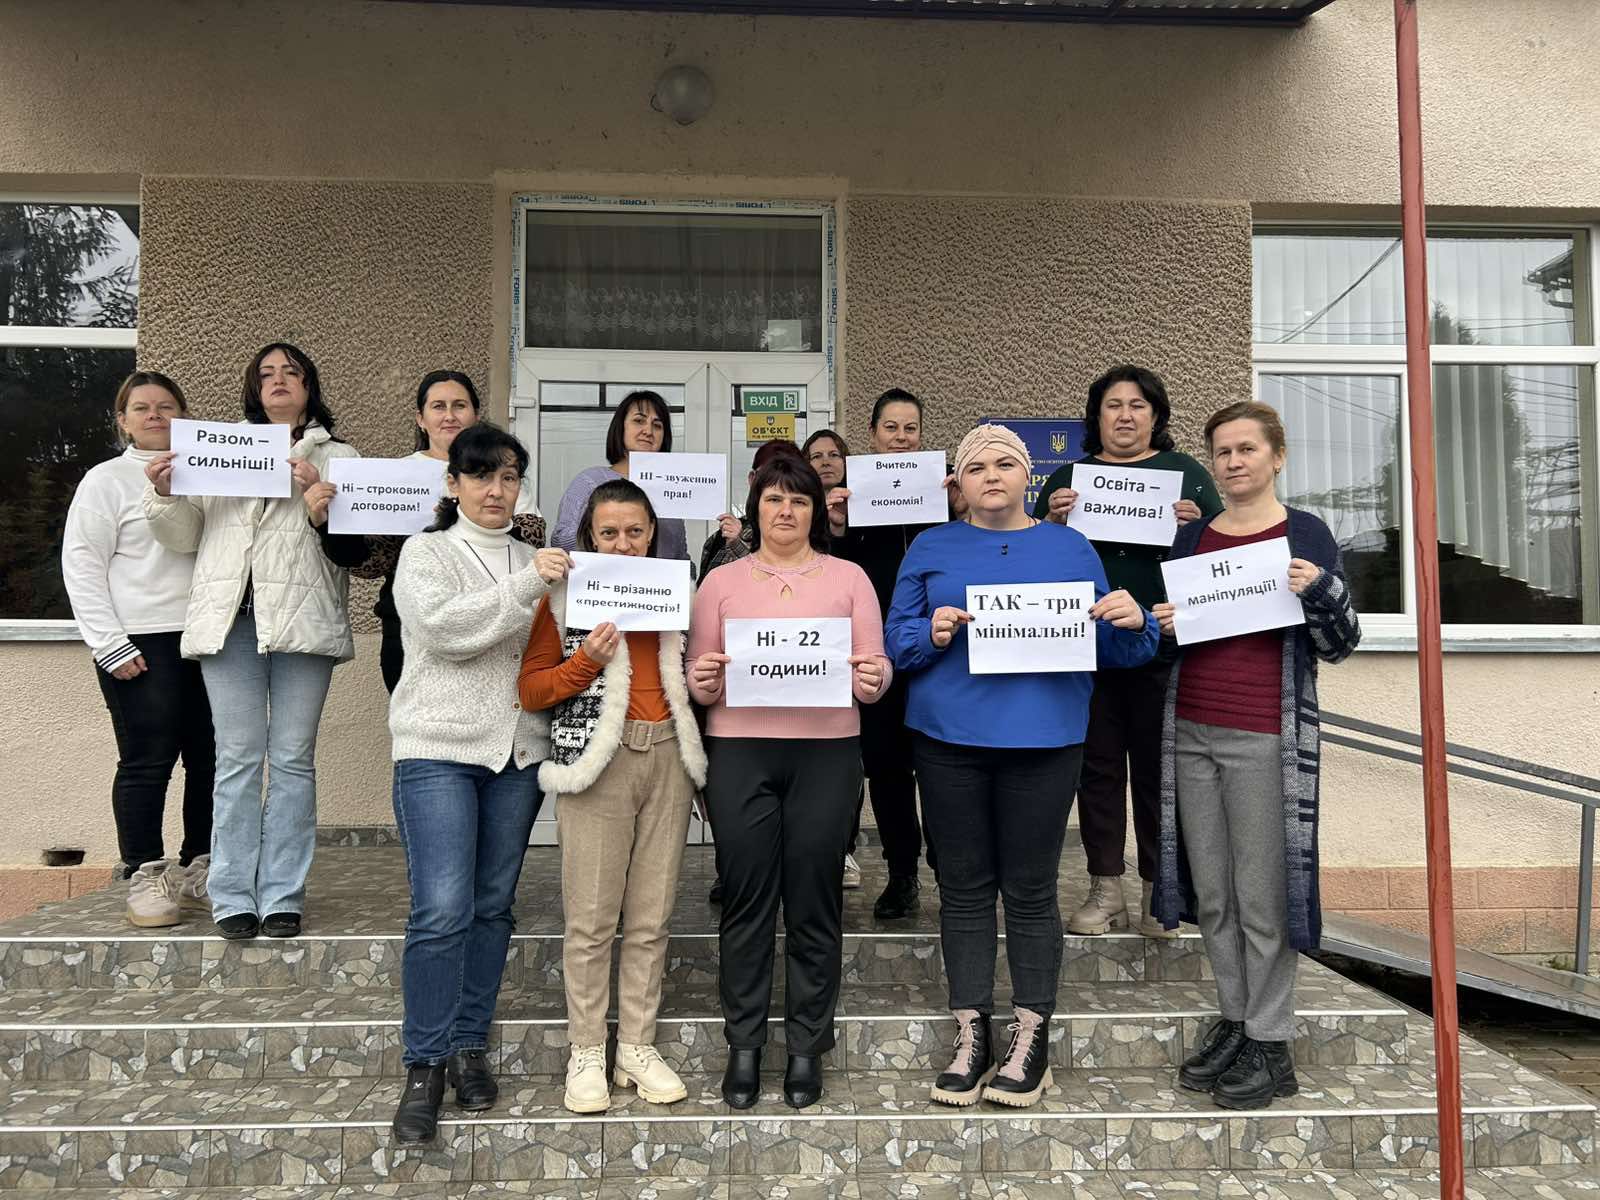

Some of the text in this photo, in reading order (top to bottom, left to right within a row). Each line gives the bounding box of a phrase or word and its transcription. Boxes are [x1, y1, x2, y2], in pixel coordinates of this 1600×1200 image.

[750, 396, 778, 408] ВХІД
[197, 429, 253, 446] Разом
[188, 456, 274, 471] сильніші!
[876, 461, 918, 470] Вчитель
[640, 472, 653, 480] НІ
[666, 475, 717, 484] звуженню
[1093, 476, 1145, 493] Освіта
[342, 483, 354, 493] Ні
[367, 486, 430, 496] строковим
[663, 490, 692, 500] прав!
[351, 502, 420, 513] договорам!
[871, 496, 923, 507] економія!
[1083, 502, 1163, 519] важлива!
[1211, 560, 1231, 578] Ні
[587, 580, 600, 591] Ні
[614, 583, 672, 596] врізанню
[1188, 578, 1277, 606] маніпуляції!
[576, 599, 680, 613] «престижності»!
[974, 594, 1021, 611] ТАК
[1045, 598, 1081, 615] три
[974, 621, 1085, 639] мінімальні!
[757, 630, 775, 647] Ні
[798, 631, 821, 646] 22
[751, 659, 826, 679] години!
